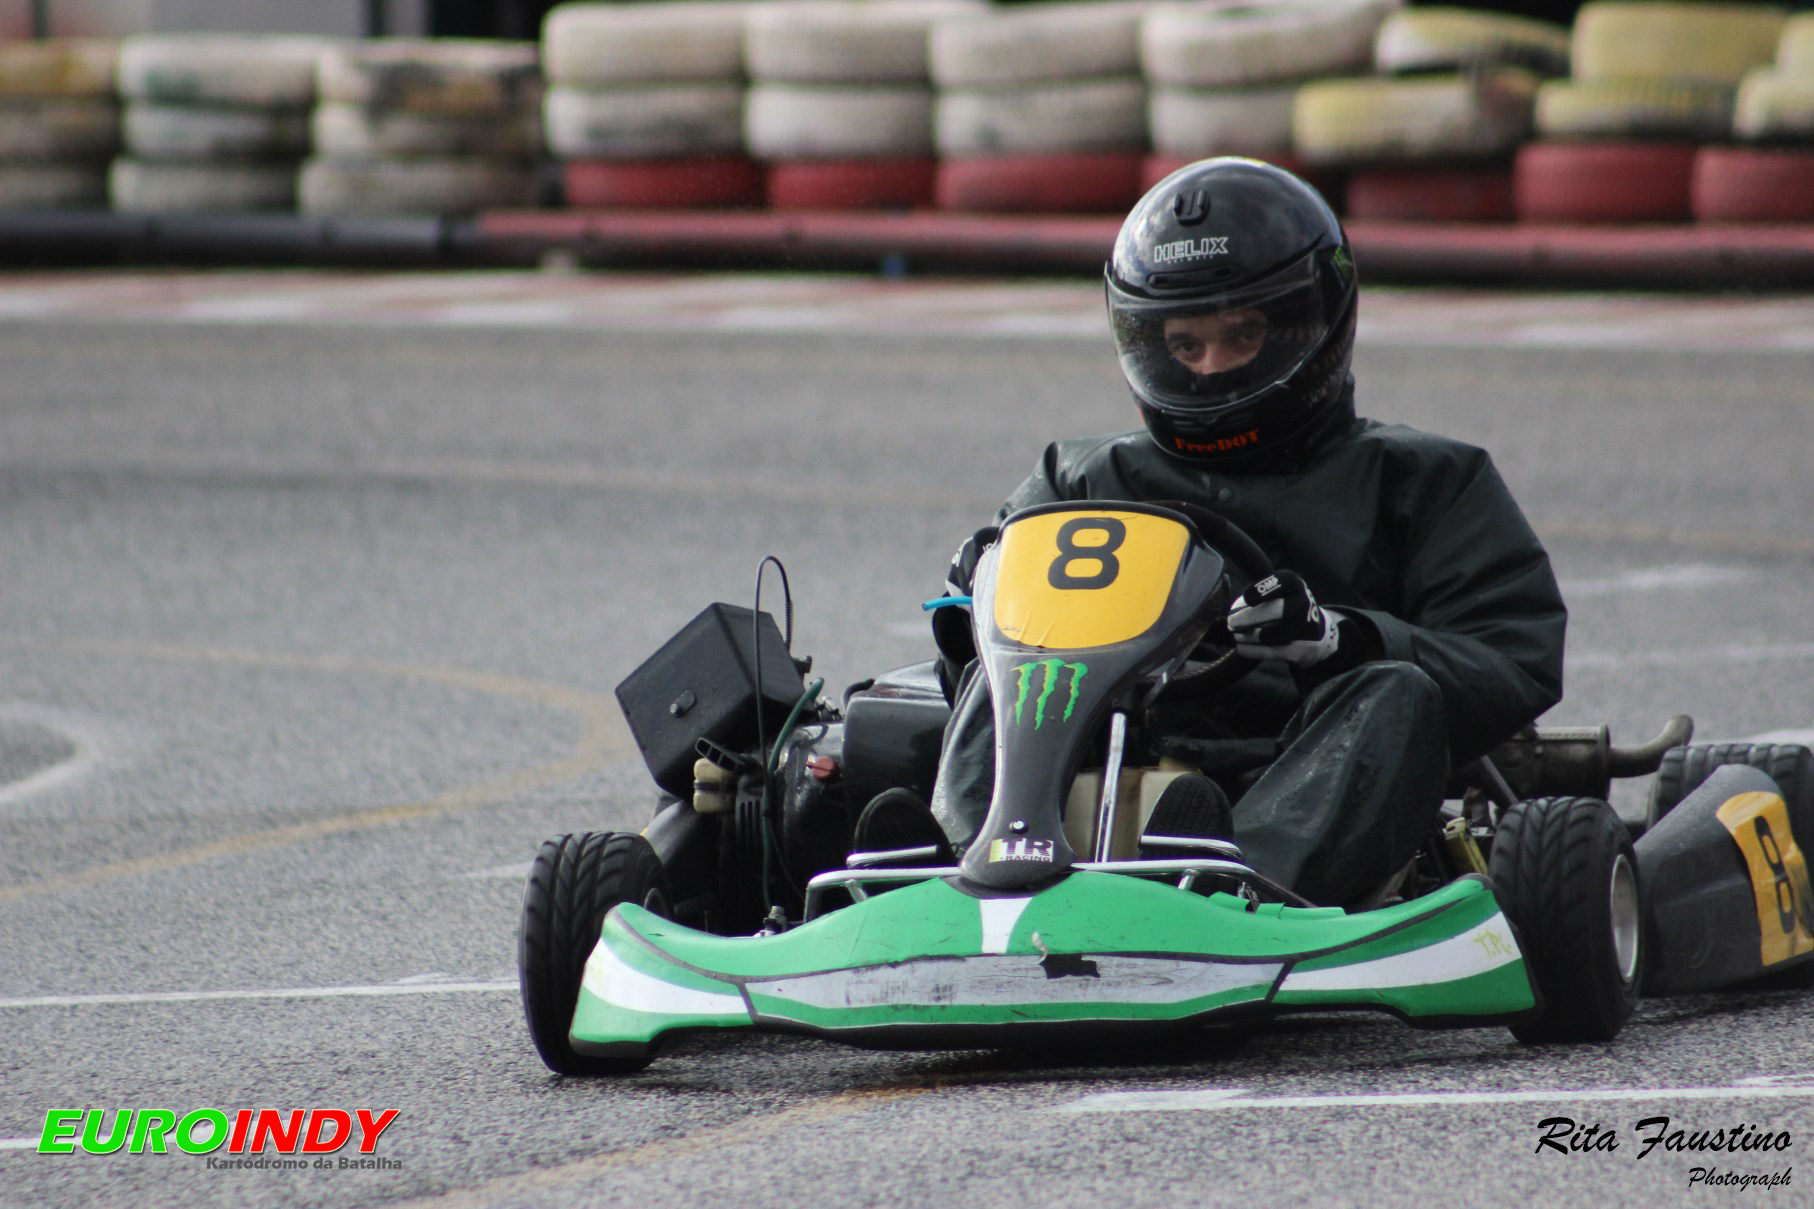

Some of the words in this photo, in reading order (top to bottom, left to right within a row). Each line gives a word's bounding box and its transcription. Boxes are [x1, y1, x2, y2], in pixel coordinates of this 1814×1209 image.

[1153, 237, 1229, 263] HELIX
[1174, 428, 1260, 453] FreeDOT
[1048, 517, 1126, 590] 8
[1256, 577, 1279, 594] OMP
[1754, 815, 1797, 935] 8
